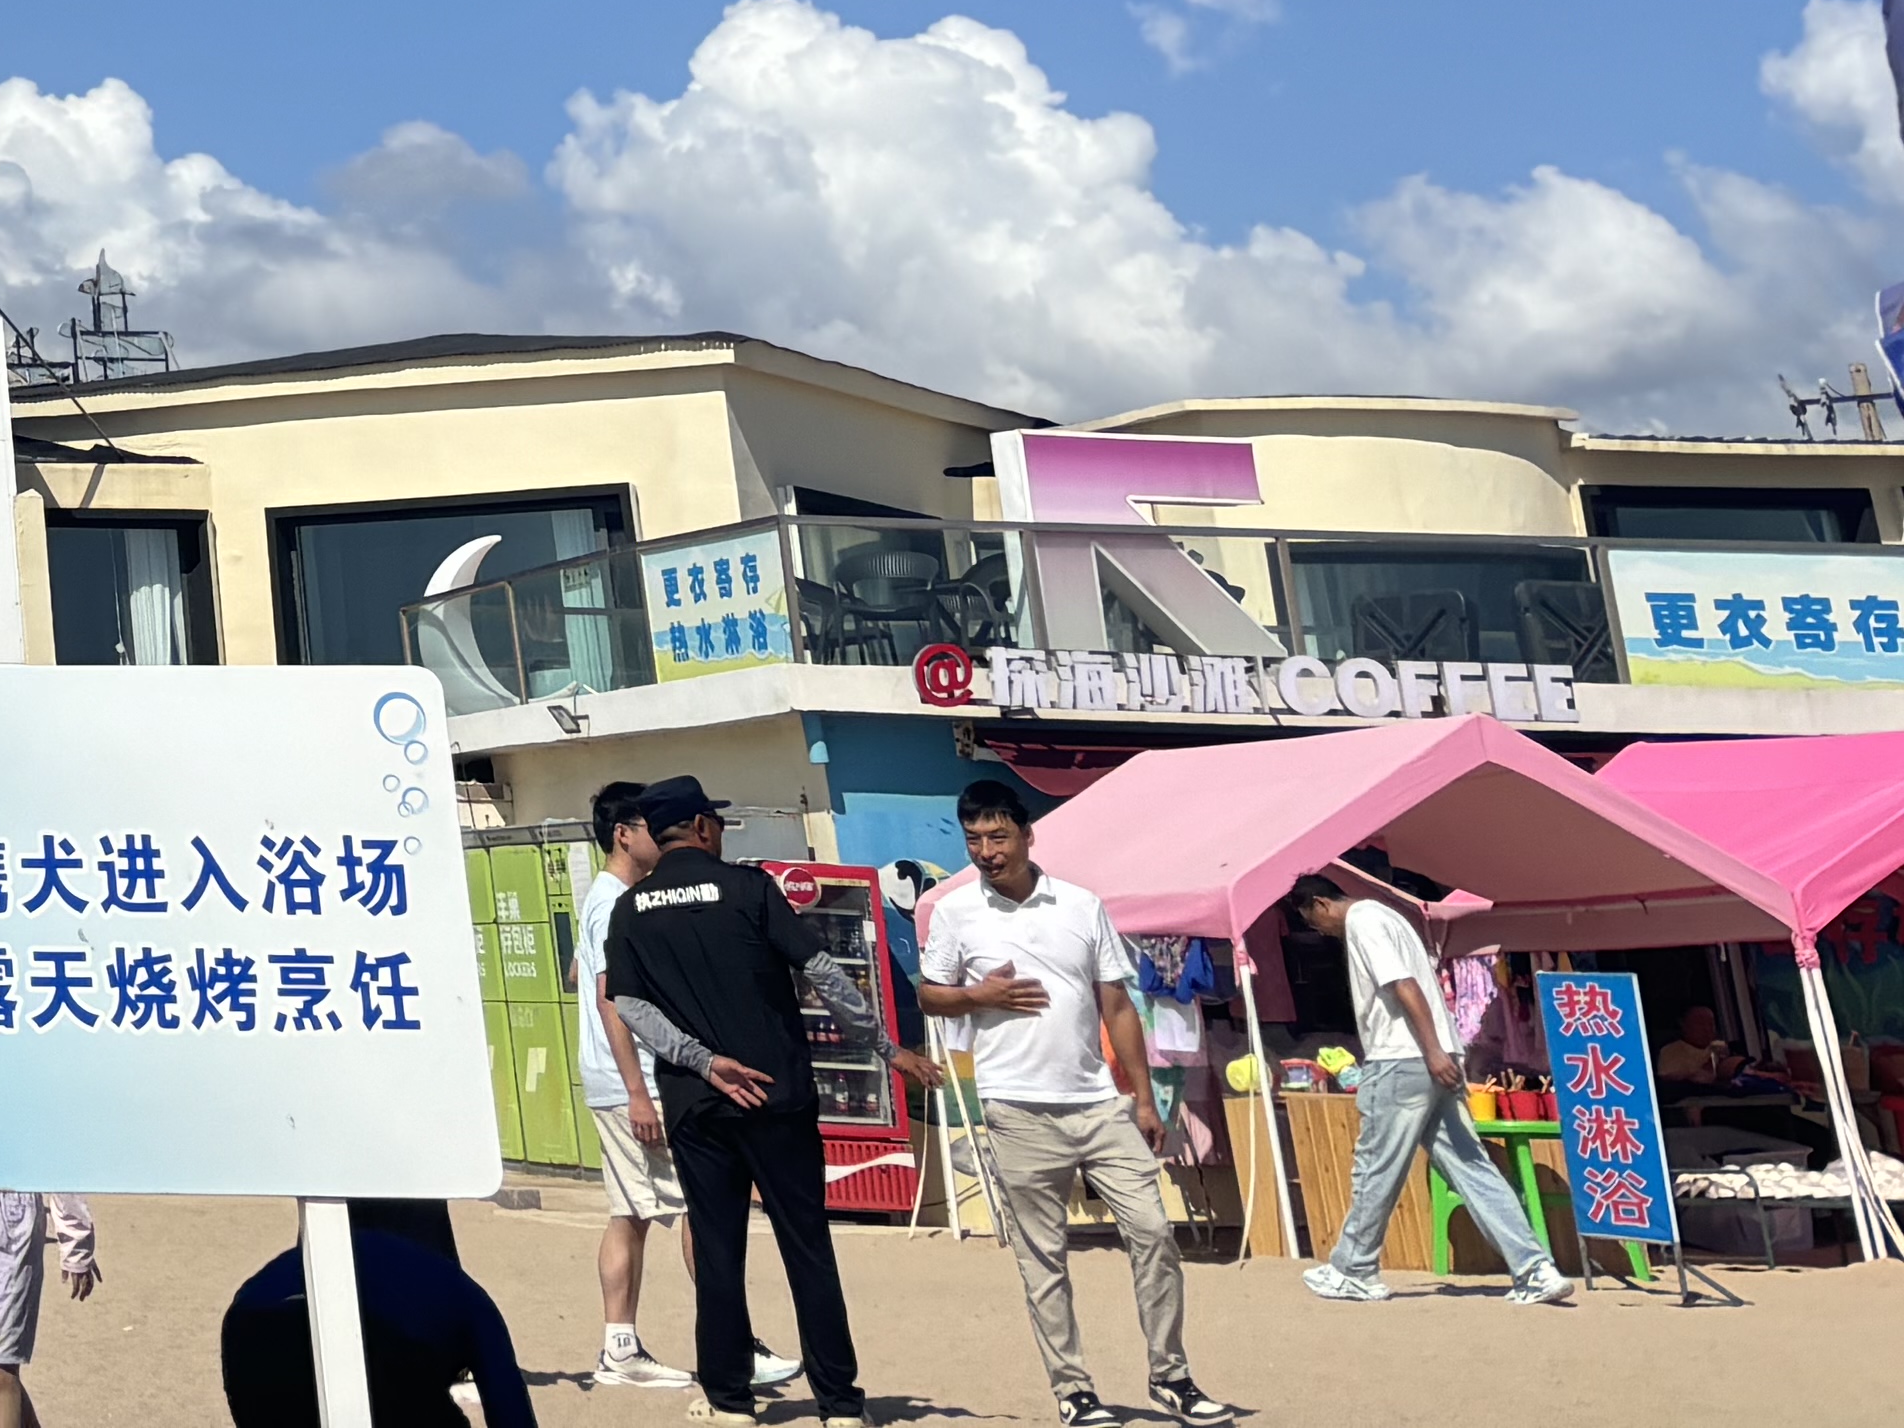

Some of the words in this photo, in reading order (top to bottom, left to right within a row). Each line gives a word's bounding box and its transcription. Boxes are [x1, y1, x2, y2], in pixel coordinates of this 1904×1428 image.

[661, 552, 761, 608] 更衣寄存
[669, 608, 769, 663] 热水淋浴
[1645, 592, 1904, 652] 更衣寄存
[1280, 655, 1580, 723] COFFEE
[1553, 982, 1652, 1228] 热水淋浴
